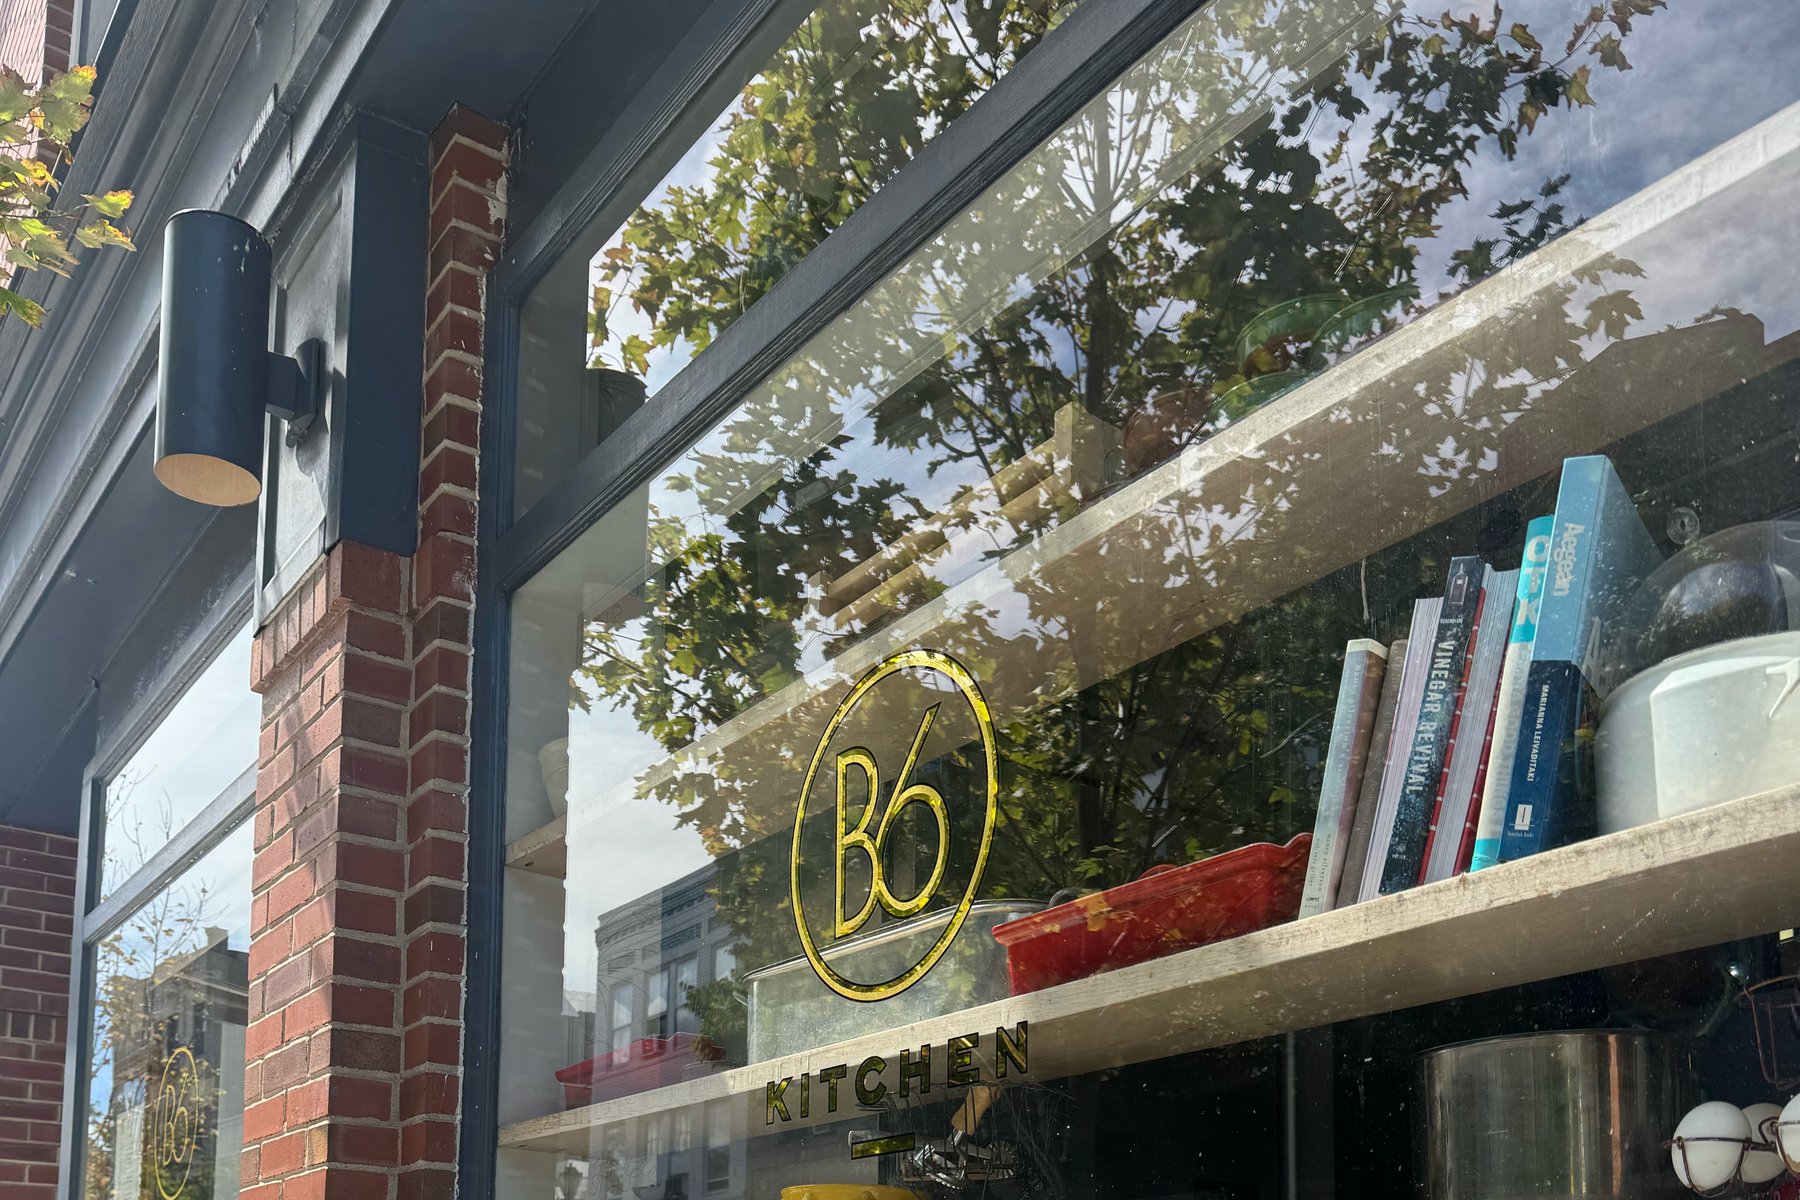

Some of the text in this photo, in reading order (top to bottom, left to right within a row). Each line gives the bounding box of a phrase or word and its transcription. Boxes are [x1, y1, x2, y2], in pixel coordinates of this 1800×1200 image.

[1552, 523, 1585, 597] Aegean
[1406, 640, 1454, 793] VINEGAR REVIVAL
[1527, 685, 1550, 782] MARIANNA LEIVADITAKI
[833, 700, 951, 941] B6
[765, 1020, 1029, 1125] KITCHEN
